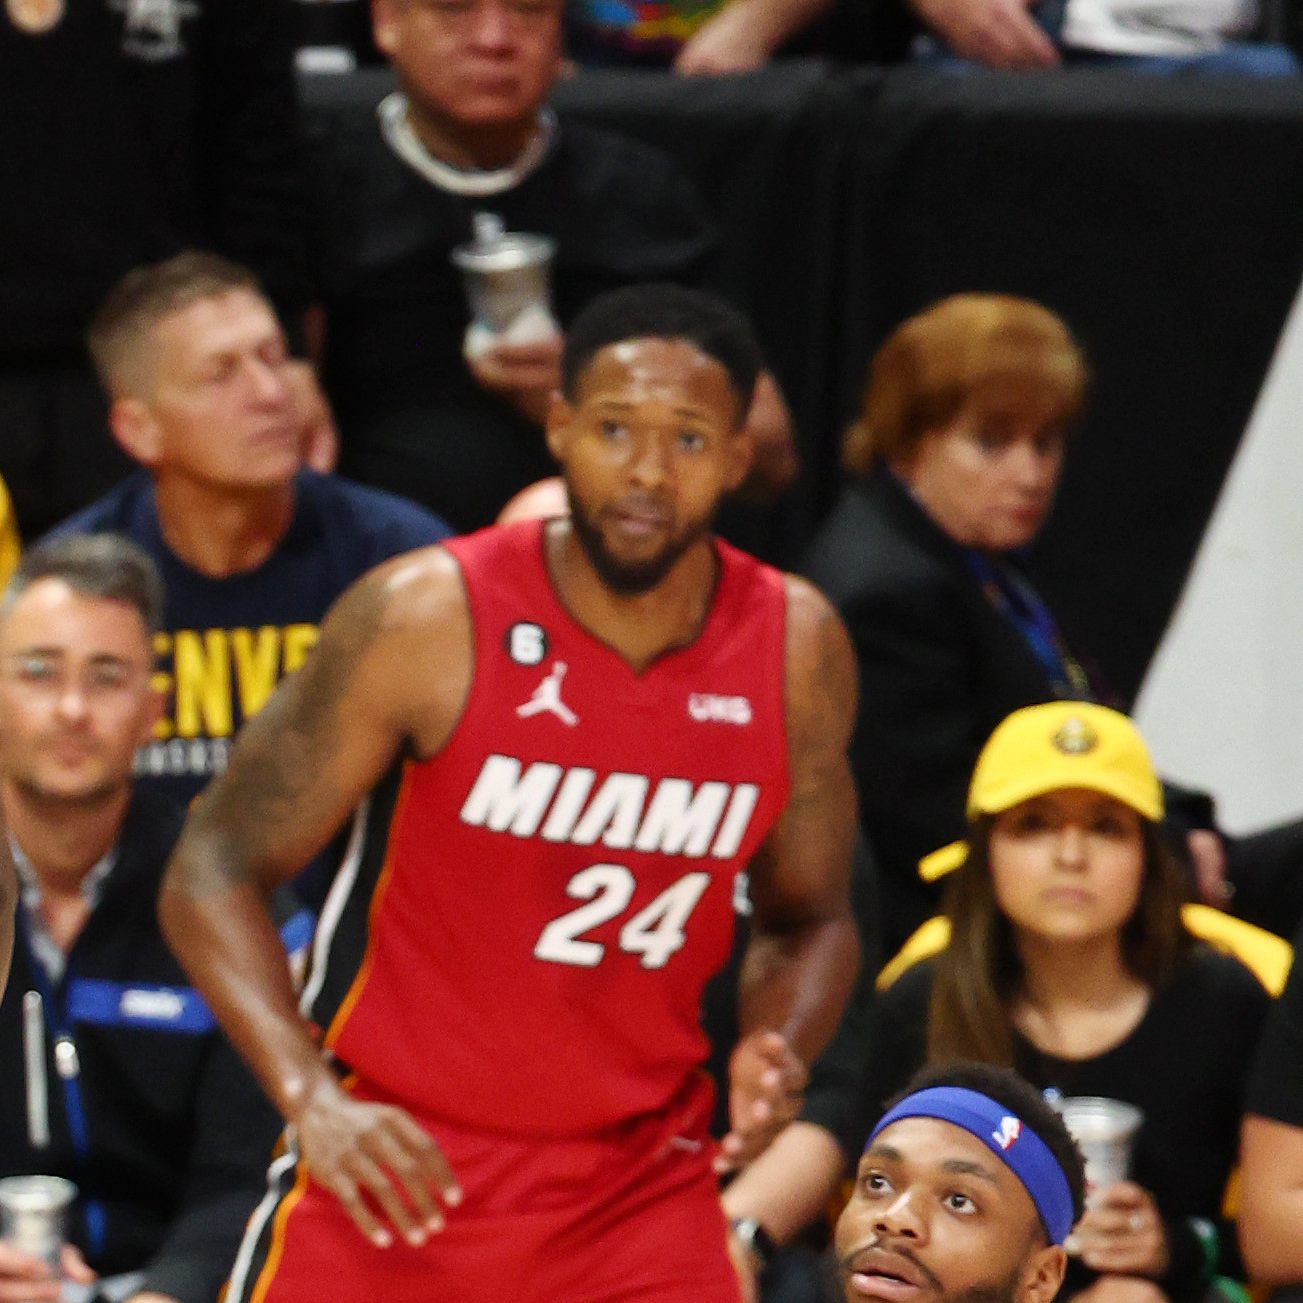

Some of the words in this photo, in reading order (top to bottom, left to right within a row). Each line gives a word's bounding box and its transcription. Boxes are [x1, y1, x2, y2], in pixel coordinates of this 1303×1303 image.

[510, 623, 546, 665] 6
[459, 753, 760, 860] MIAMI
[533, 862, 711, 970] 24
